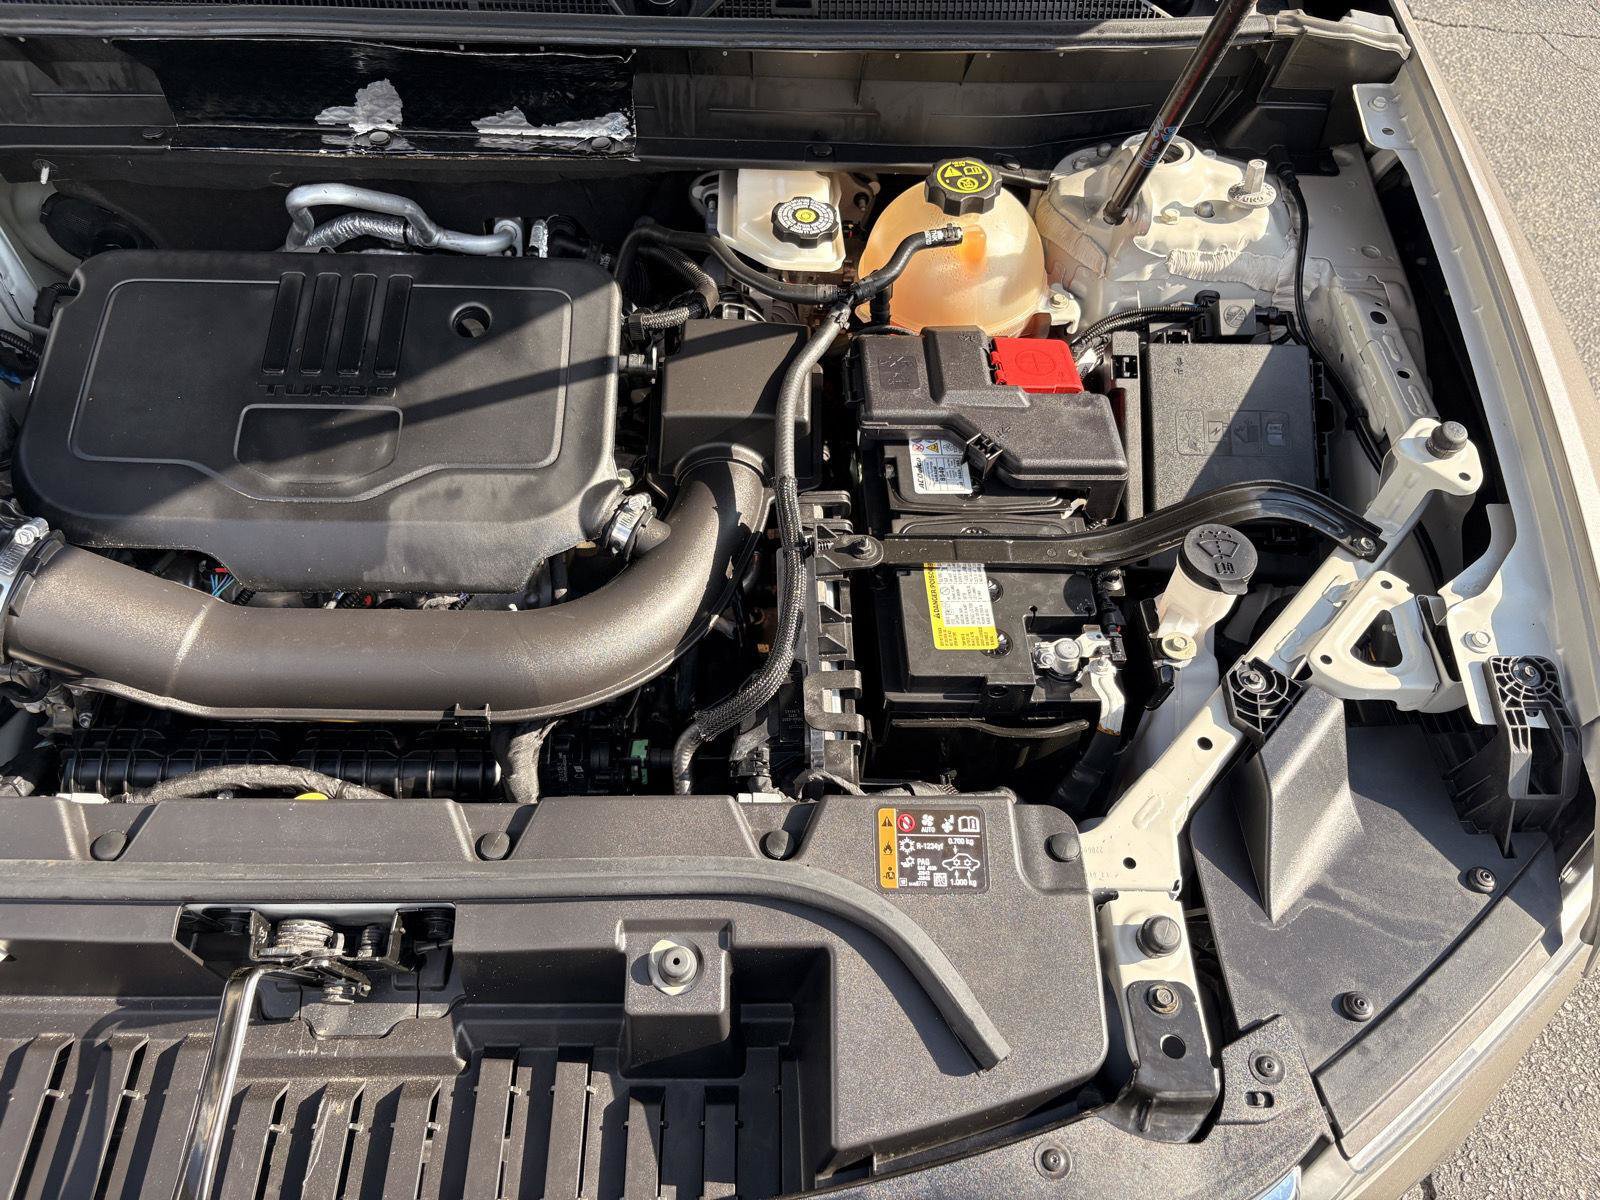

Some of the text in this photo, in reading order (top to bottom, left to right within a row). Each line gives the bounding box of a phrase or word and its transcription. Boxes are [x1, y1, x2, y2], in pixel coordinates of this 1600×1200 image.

[257, 383, 397, 398] TURBO
[916, 457, 925, 489] ACDelco
[948, 837, 974, 846] 0.700 kg
[916, 842, 944, 851] R-1234yf
[917, 858, 930, 866] PAG
[968, 879, 977, 887] kg
